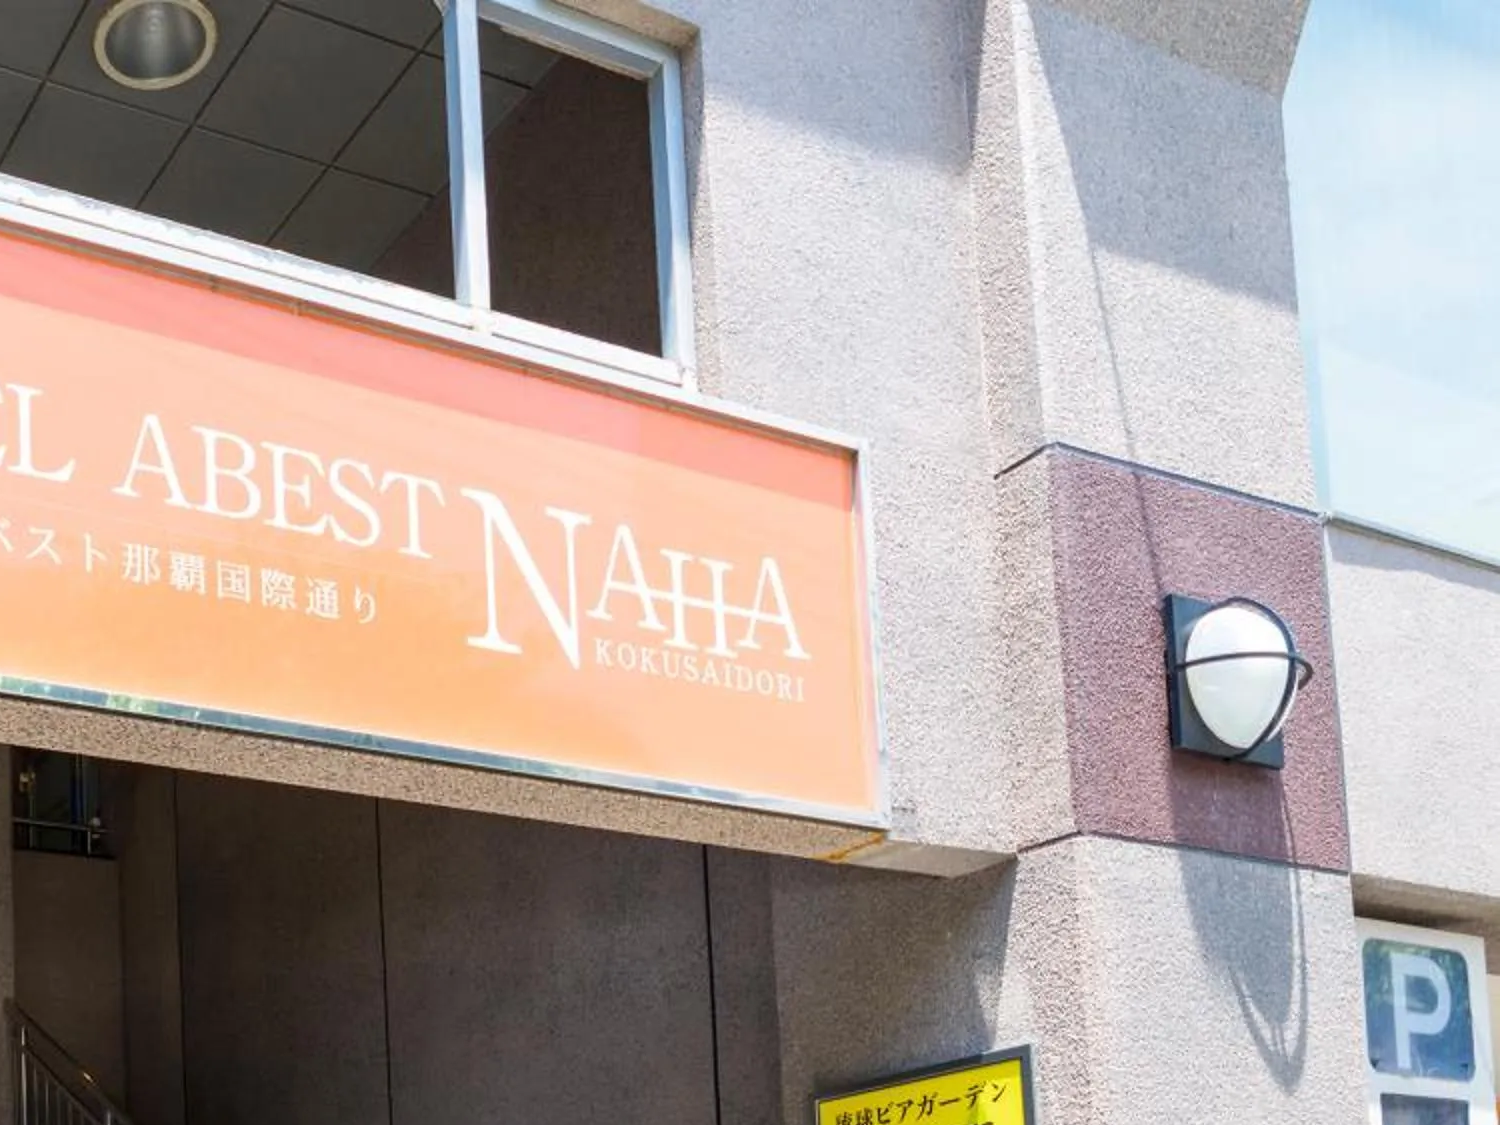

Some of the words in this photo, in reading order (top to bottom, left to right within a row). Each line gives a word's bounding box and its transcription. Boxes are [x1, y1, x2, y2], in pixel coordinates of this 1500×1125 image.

[111, 413, 446, 560] ABEST
[460, 486, 811, 670] NAHA
[594, 636, 808, 704] KOKUSAIDORI
[1391, 952, 1452, 1070] P
